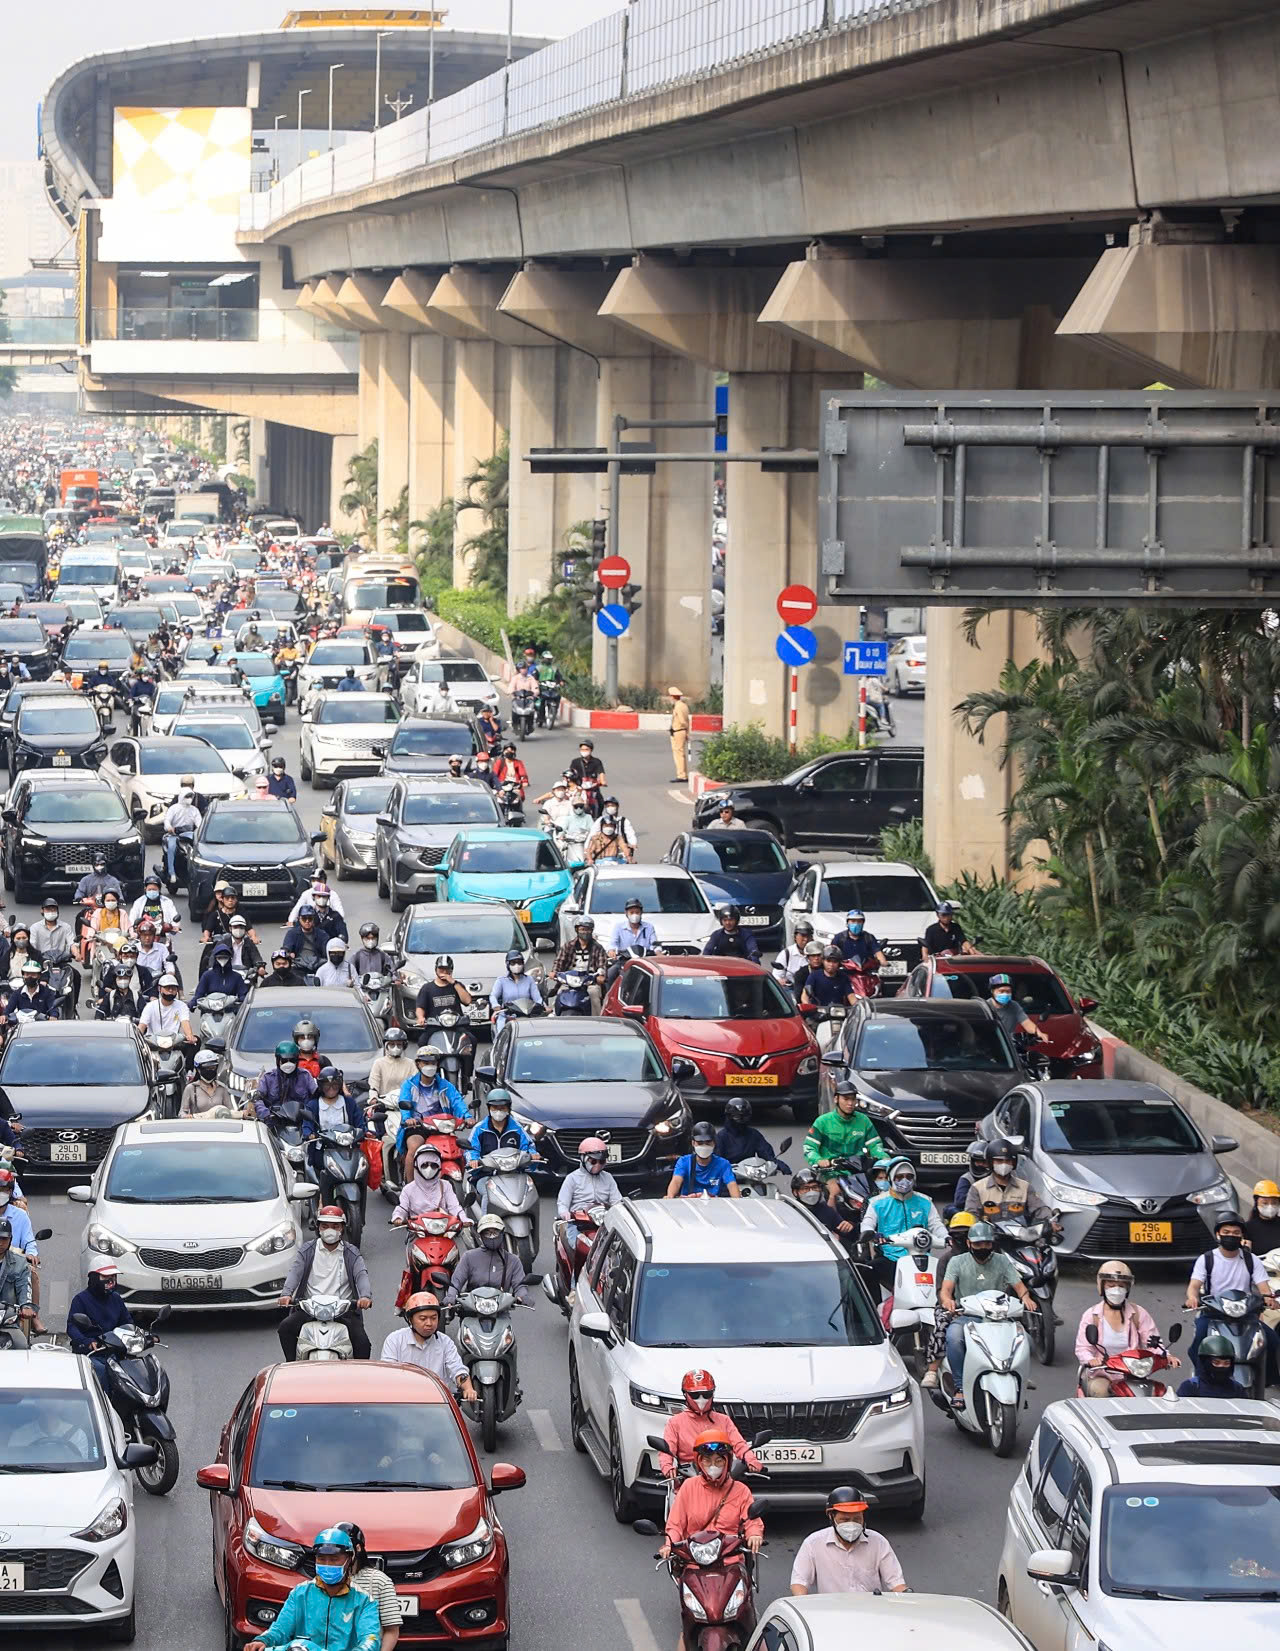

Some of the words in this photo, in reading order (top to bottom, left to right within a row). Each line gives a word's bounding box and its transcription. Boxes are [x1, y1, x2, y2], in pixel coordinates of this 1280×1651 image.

[730, 1076, 774, 1085] 29K-022.56
[1142, 1224, 1160, 1232] 29G
[1135, 1234, 1167, 1242] 015.04
[164, 1277, 220, 1289] 30A-985.54
[756, 1449, 815, 1461] 0K-835.42
